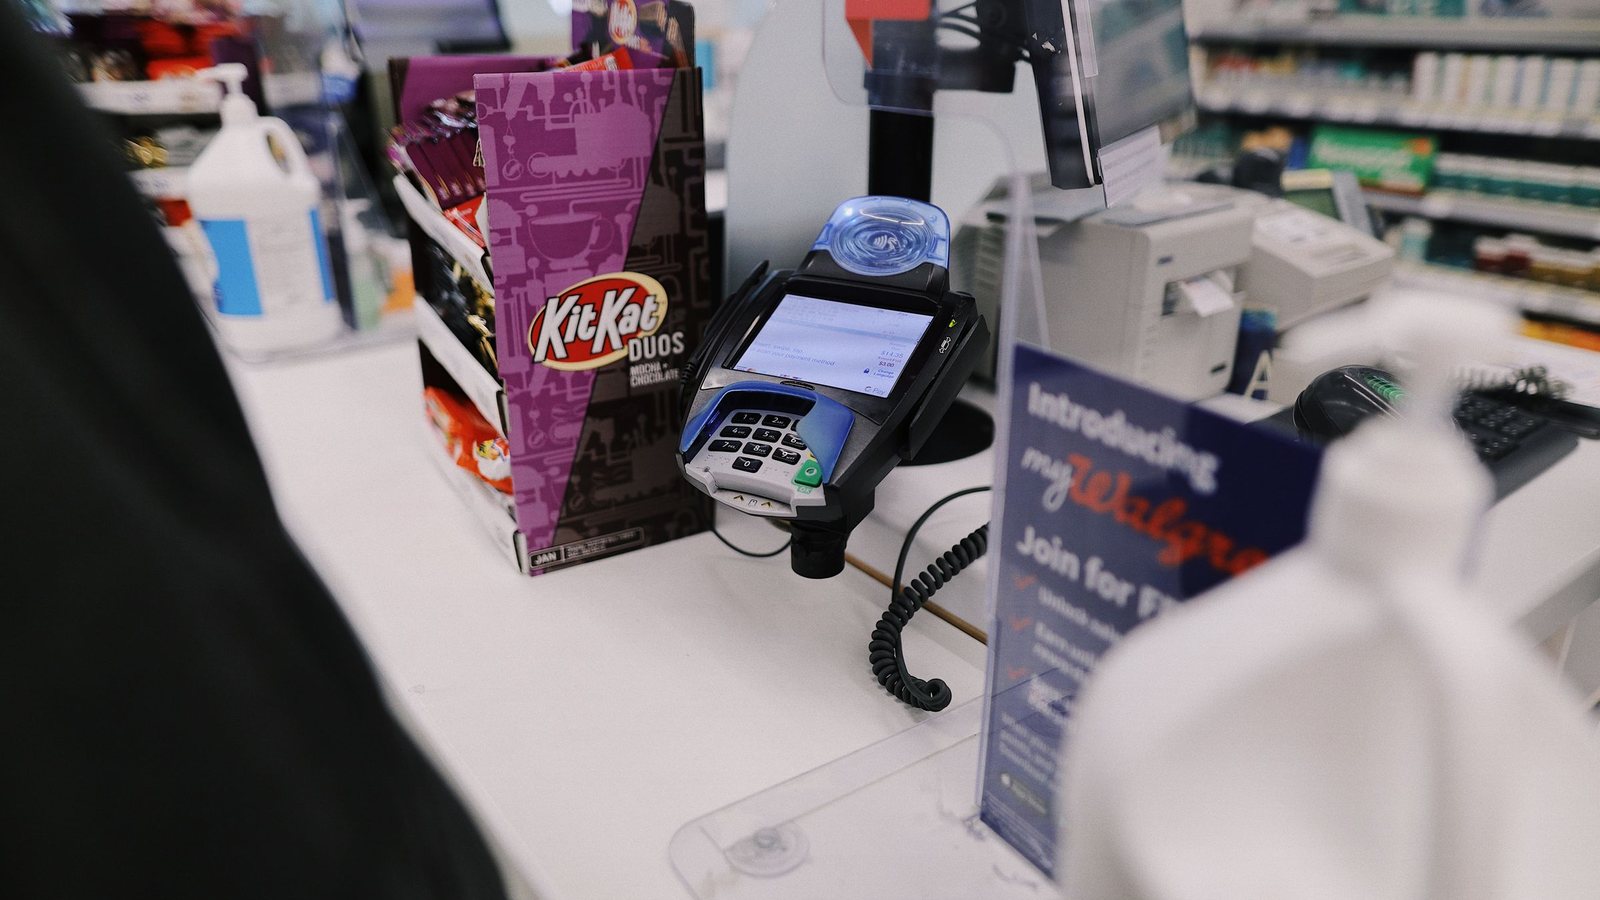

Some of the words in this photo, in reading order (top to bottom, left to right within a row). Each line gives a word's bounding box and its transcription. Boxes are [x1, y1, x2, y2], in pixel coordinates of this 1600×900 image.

[534, 287, 659, 364] KitKat
[628, 331, 685, 362] DUOS
[630, 362, 661, 377] MOCHA
[630, 367, 680, 388] CHOCOLATE
[1028, 381, 1220, 494] Introducing
[535, 551, 557, 566] JAN
[1016, 525, 1081, 583] Join
[1084, 555, 1136, 607] for
